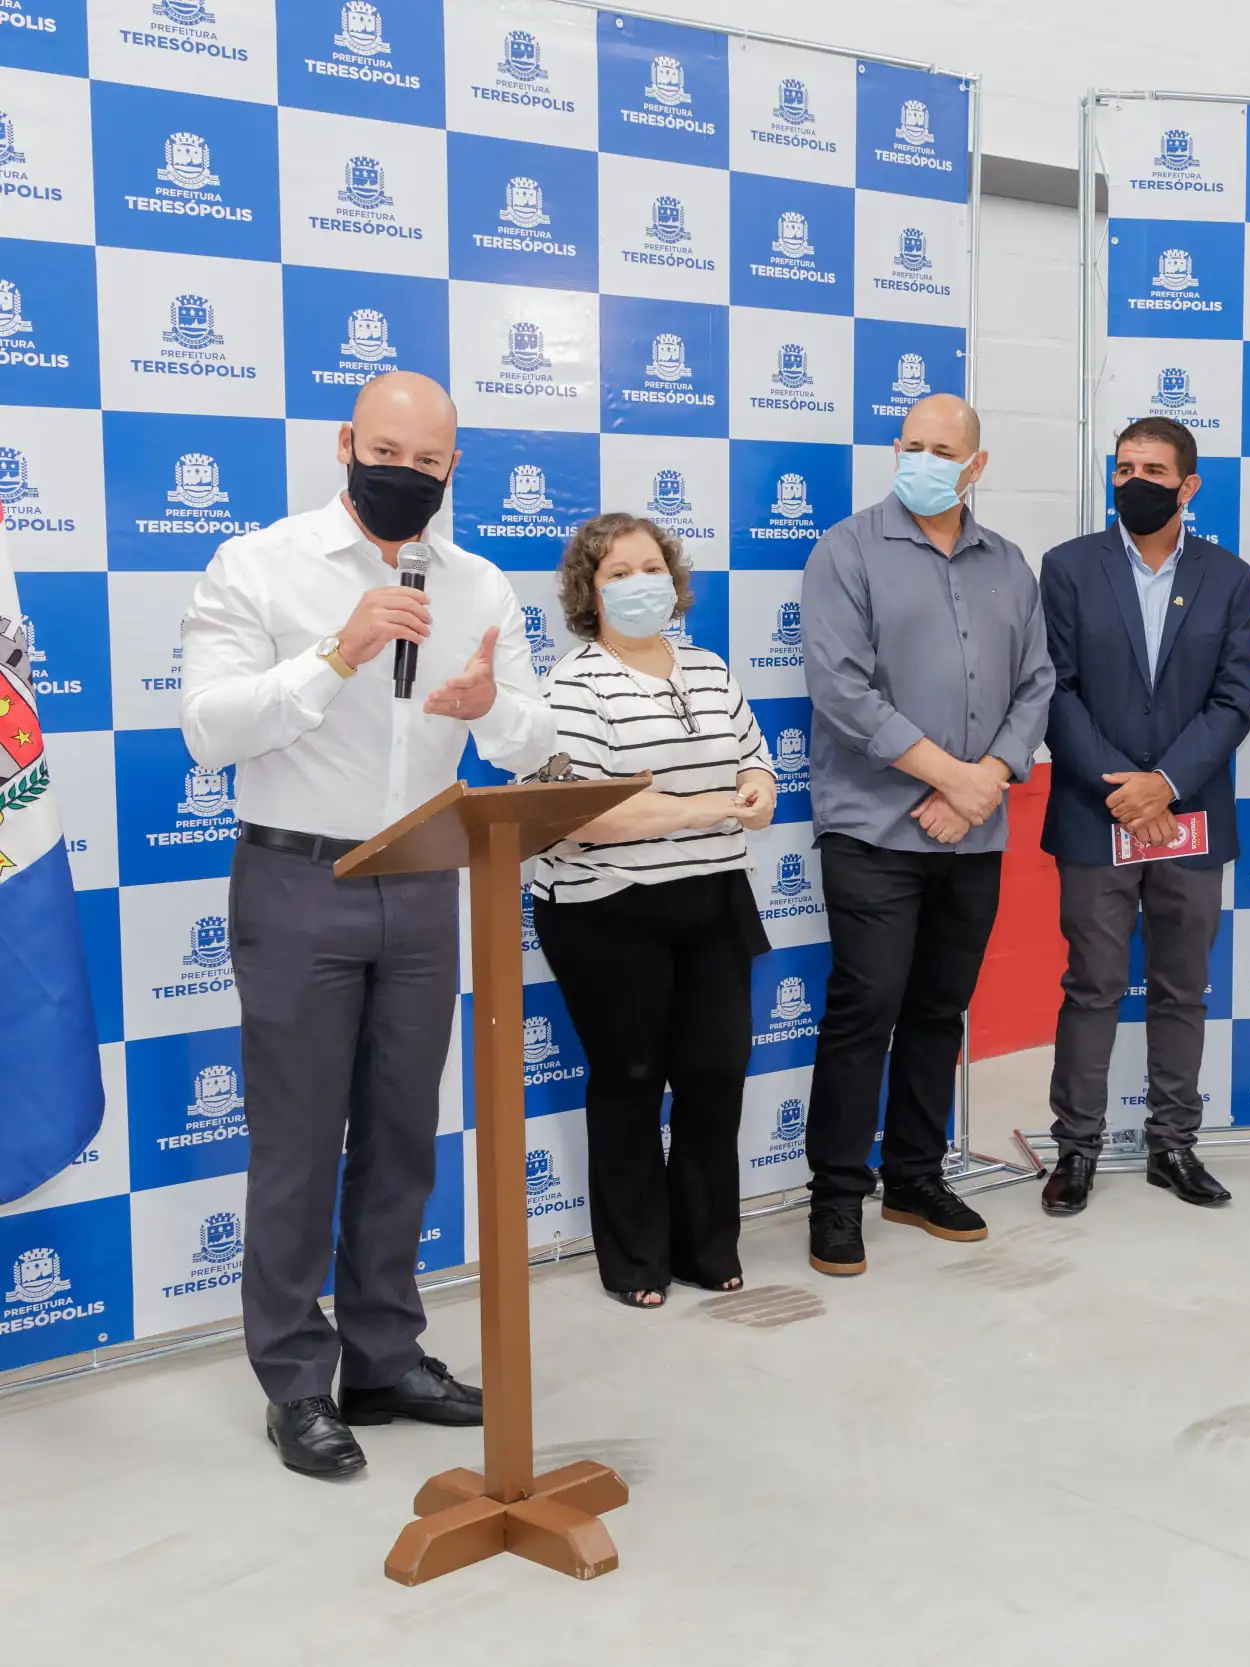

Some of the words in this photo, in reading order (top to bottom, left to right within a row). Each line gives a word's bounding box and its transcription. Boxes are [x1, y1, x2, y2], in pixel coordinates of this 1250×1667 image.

[150, 22, 218, 41] PREFEITURA
[119, 29, 249, 62] TERESÓPOLIS
[332, 52, 393, 70] PREFEITURA
[304, 59, 421, 90] TERESÓPOLIS
[495, 78, 550, 95] PREFEITURA
[470, 85, 575, 113] TERESÓPOLIS
[643, 102, 693, 117] PREFEITURA
[621, 109, 715, 135] TERESÓPOLIS
[771, 122, 816, 137] PREFEITURA
[750, 129, 836, 153] TERESÓPOLIS
[893, 142, 934, 156] PREFEITURA
[874, 149, 953, 172] TERESÓPOLIS
[1128, 178, 1225, 193] TERESÓPOLIS
[155, 187, 222, 203] PREFEITURA
[124, 195, 253, 222] TERESÓPOLIS
[336, 207, 396, 222] PREFEITURA
[308, 215, 423, 240] TERESÓPOLIS
[498, 226, 552, 239] PREFEITURA
[473, 234, 576, 257] TERESÓPOLIS
[644, 242, 693, 255] PREFEITURA
[621, 250, 715, 271] TERESÓPOLIS
[770, 256, 815, 268] PREFEITURA
[750, 264, 835, 284] TERESÓPOLIS
[892, 270, 933, 282] PREFEITURA
[873, 277, 951, 296] TERESÓPOLIS
[1127, 297, 1223, 311] TERESÓPOLIS
[0, 347, 70, 368] ÓPOLIS
[160, 349, 227, 361] PREFEITURA
[129, 359, 257, 379] TERESÓPOLIS
[339, 361, 399, 372] PREFEITURA
[499, 372, 553, 383] PREFEITURA
[644, 381, 693, 391] PREFEITURA
[475, 381, 577, 398] TERESÓPOLIS
[622, 389, 715, 406] TERESÓPOLIS
[770, 388, 815, 398] PREFEITURA
[750, 396, 834, 412] TERESÓPOLIS
[165, 509, 231, 518] PREFEITURA
[501, 515, 555, 523] PREFEITURA
[4, 514, 76, 532] ÓPOLIS
[135, 517, 261, 534] TERESÓPOLIS
[477, 522, 578, 537] TERESÓPOLIS
[749, 653, 805, 667] TERESÓP
[145, 825, 240, 847] TERESÓPO
[769, 895, 813, 907] PREFEITURA
[758, 902, 826, 921] ERESÓPOLI
[180, 966, 235, 981] PREFEITUR
[151, 976, 234, 1000] TERESÓP
[769, 1017, 812, 1030] PREFEITURA
[751, 1024, 821, 1046] TERESÓPOL
[522, 1059, 561, 1073] FEITURA
[523, 1065, 584, 1086] SÓPOLIS
[156, 1123, 250, 1151] TERESÓPO
[749, 1147, 805, 1169] TERESÓP
[526, 1191, 562, 1206] FEITURA
[526, 1195, 585, 1219] SÓPOLIS
[190, 1259, 243, 1278] PREFEITUR
[161, 1270, 242, 1300] TERESÓP
[3, 1296, 74, 1319] PREFEITURA
[0, 1300, 106, 1336] RESÓPOLIS
